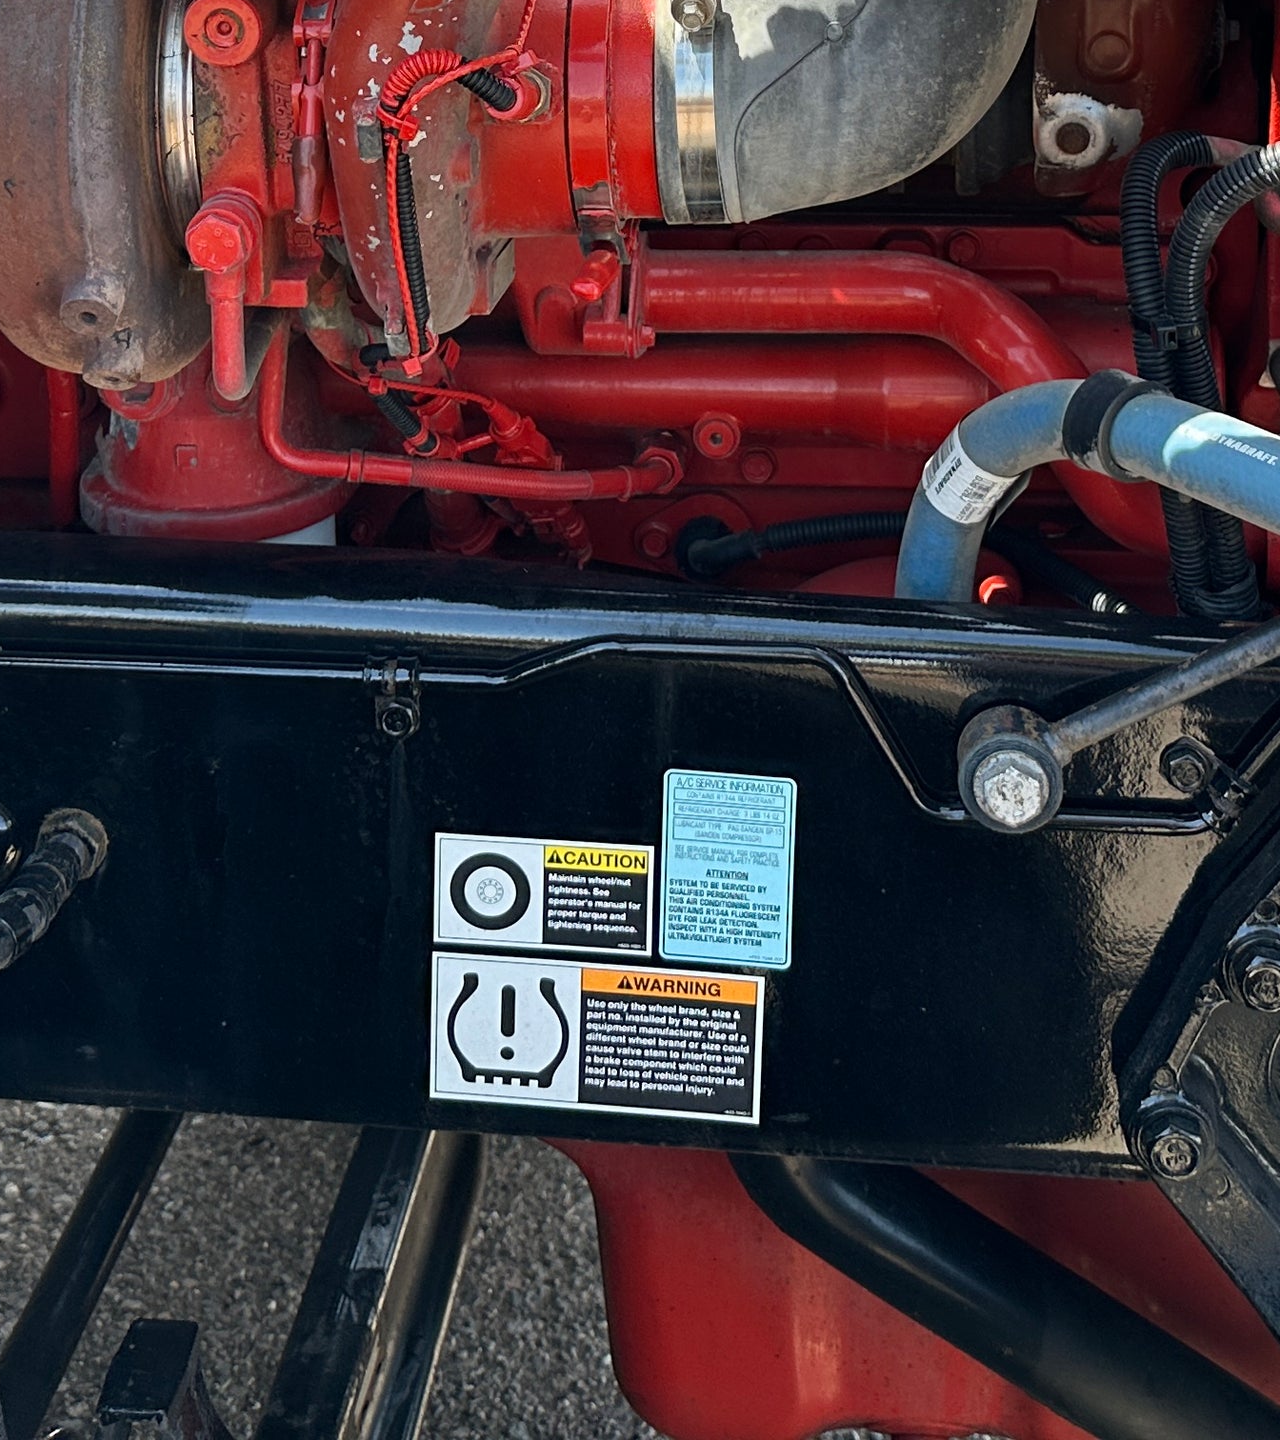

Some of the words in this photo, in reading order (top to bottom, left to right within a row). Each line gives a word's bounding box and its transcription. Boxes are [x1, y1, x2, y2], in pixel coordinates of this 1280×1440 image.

[676, 776, 694, 789] A/C
[695, 778, 726, 789] SERVICE
[729, 780, 783, 796] INFORMATION
[564, 851, 646, 869] CAUTION
[548, 872, 586, 883] Maintain
[587, 876, 631, 886] wheel/nut
[548, 884, 591, 895] tightness.
[592, 887, 610, 896] See
[548, 897, 593, 907] operator's
[594, 900, 627, 909] manual
[628, 901, 641, 910] for
[547, 909, 577, 918] proper
[578, 910, 608, 920] torque
[609, 912, 626, 921] and
[547, 919, 591, 931] tightening
[592, 923, 637, 933] sequence.
[634, 976, 721, 997] WARNING
[586, 998, 606, 1008] Use
[607, 1000, 629, 1012] only
[630, 1001, 647, 1012] the
[648, 1003, 676, 1013] wheel
[678, 1005, 709, 1017] brand,
[711, 1008, 731, 1018] size
[586, 1011, 606, 1020] part
[607, 1012, 623, 1020] no.
[625, 1012, 666, 1024] installed
[668, 1015, 680, 1027] by
[682, 1017, 698, 1026] the
[699, 1018, 736, 1030] original
[585, 1022, 637, 1033] equipment
[638, 1026, 705, 1038] manufacturer.
[707, 1030, 727, 1040] Use
[728, 1032, 738, 1041] of
[740, 1034, 747, 1042] a
[585, 1032, 626, 1043] different
[627, 1036, 656, 1046] wheel
[658, 1037, 686, 1048] brand
[688, 1041, 699, 1049] or
[700, 1042, 721, 1051] size
[722, 1044, 749, 1054] could
[585, 1044, 615, 1053] cause
[616, 1046, 642, 1056] valve
[643, 1048, 667, 1057] stem
[669, 1049, 679, 1058] to
[681, 1050, 722, 1062] interfere
[723, 1054, 744, 1064] with
[584, 1055, 591, 1063] a
[593, 1054, 621, 1065] brake
[622, 1058, 676, 1070] component
[678, 1061, 707, 1072] which
[708, 1065, 736, 1074] could
[584, 1064, 605, 1075] lead
[607, 1067, 617, 1076] to
[619, 1067, 640, 1078] loss
[641, 1069, 652, 1078] of
[653, 1071, 688, 1081] vehicle
[689, 1074, 724, 1084] control
[725, 1077, 744, 1087] and
[584, 1077, 605, 1088] may
[606, 1077, 627, 1088] lead
[629, 1079, 639, 1088] to
[641, 1081, 683, 1092] personal
[685, 1083, 715, 1096] injury.
